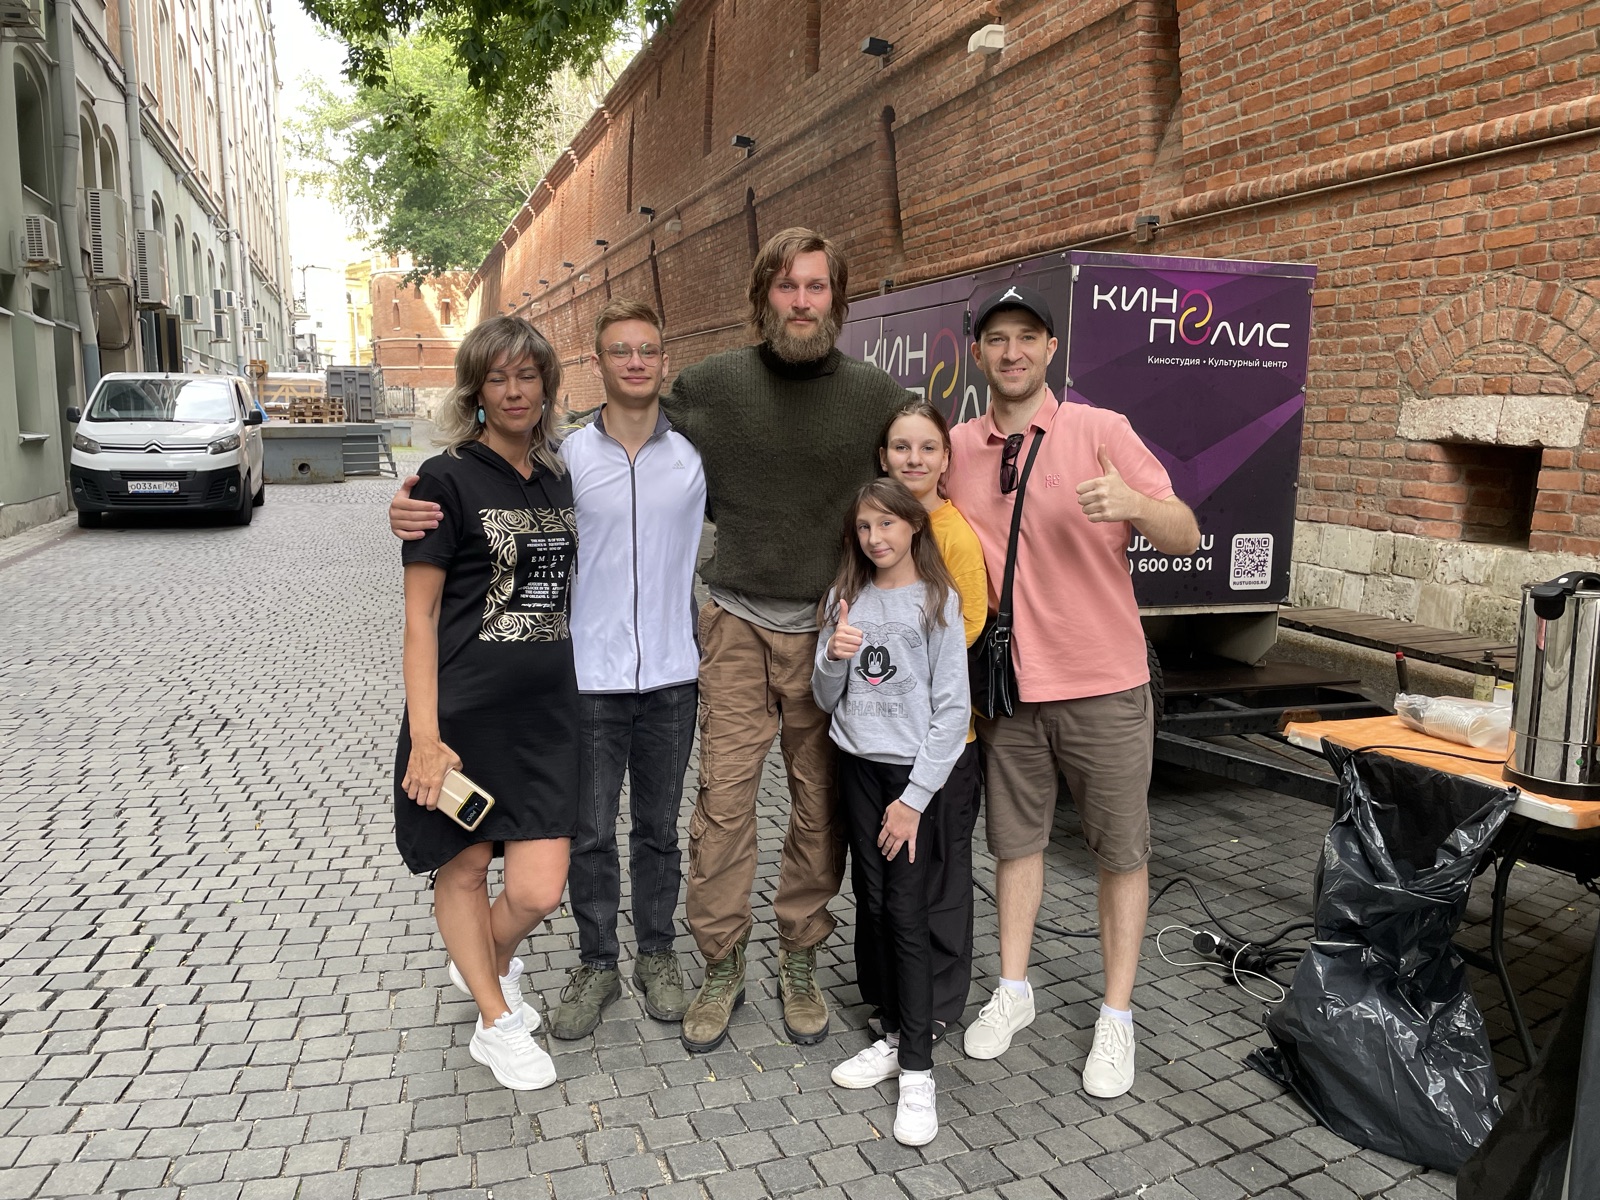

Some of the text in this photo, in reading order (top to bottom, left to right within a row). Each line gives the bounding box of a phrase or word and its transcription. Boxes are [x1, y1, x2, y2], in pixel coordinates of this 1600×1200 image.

[1147, 356, 1288, 369] Киностудия Культурный центр
[531, 555, 565, 563] EMLY
[1138, 557, 1169, 573] 600
[1172, 557, 1192, 572] 03
[1196, 556, 1213, 572] 01
[845, 701, 908, 718] CHANEL
